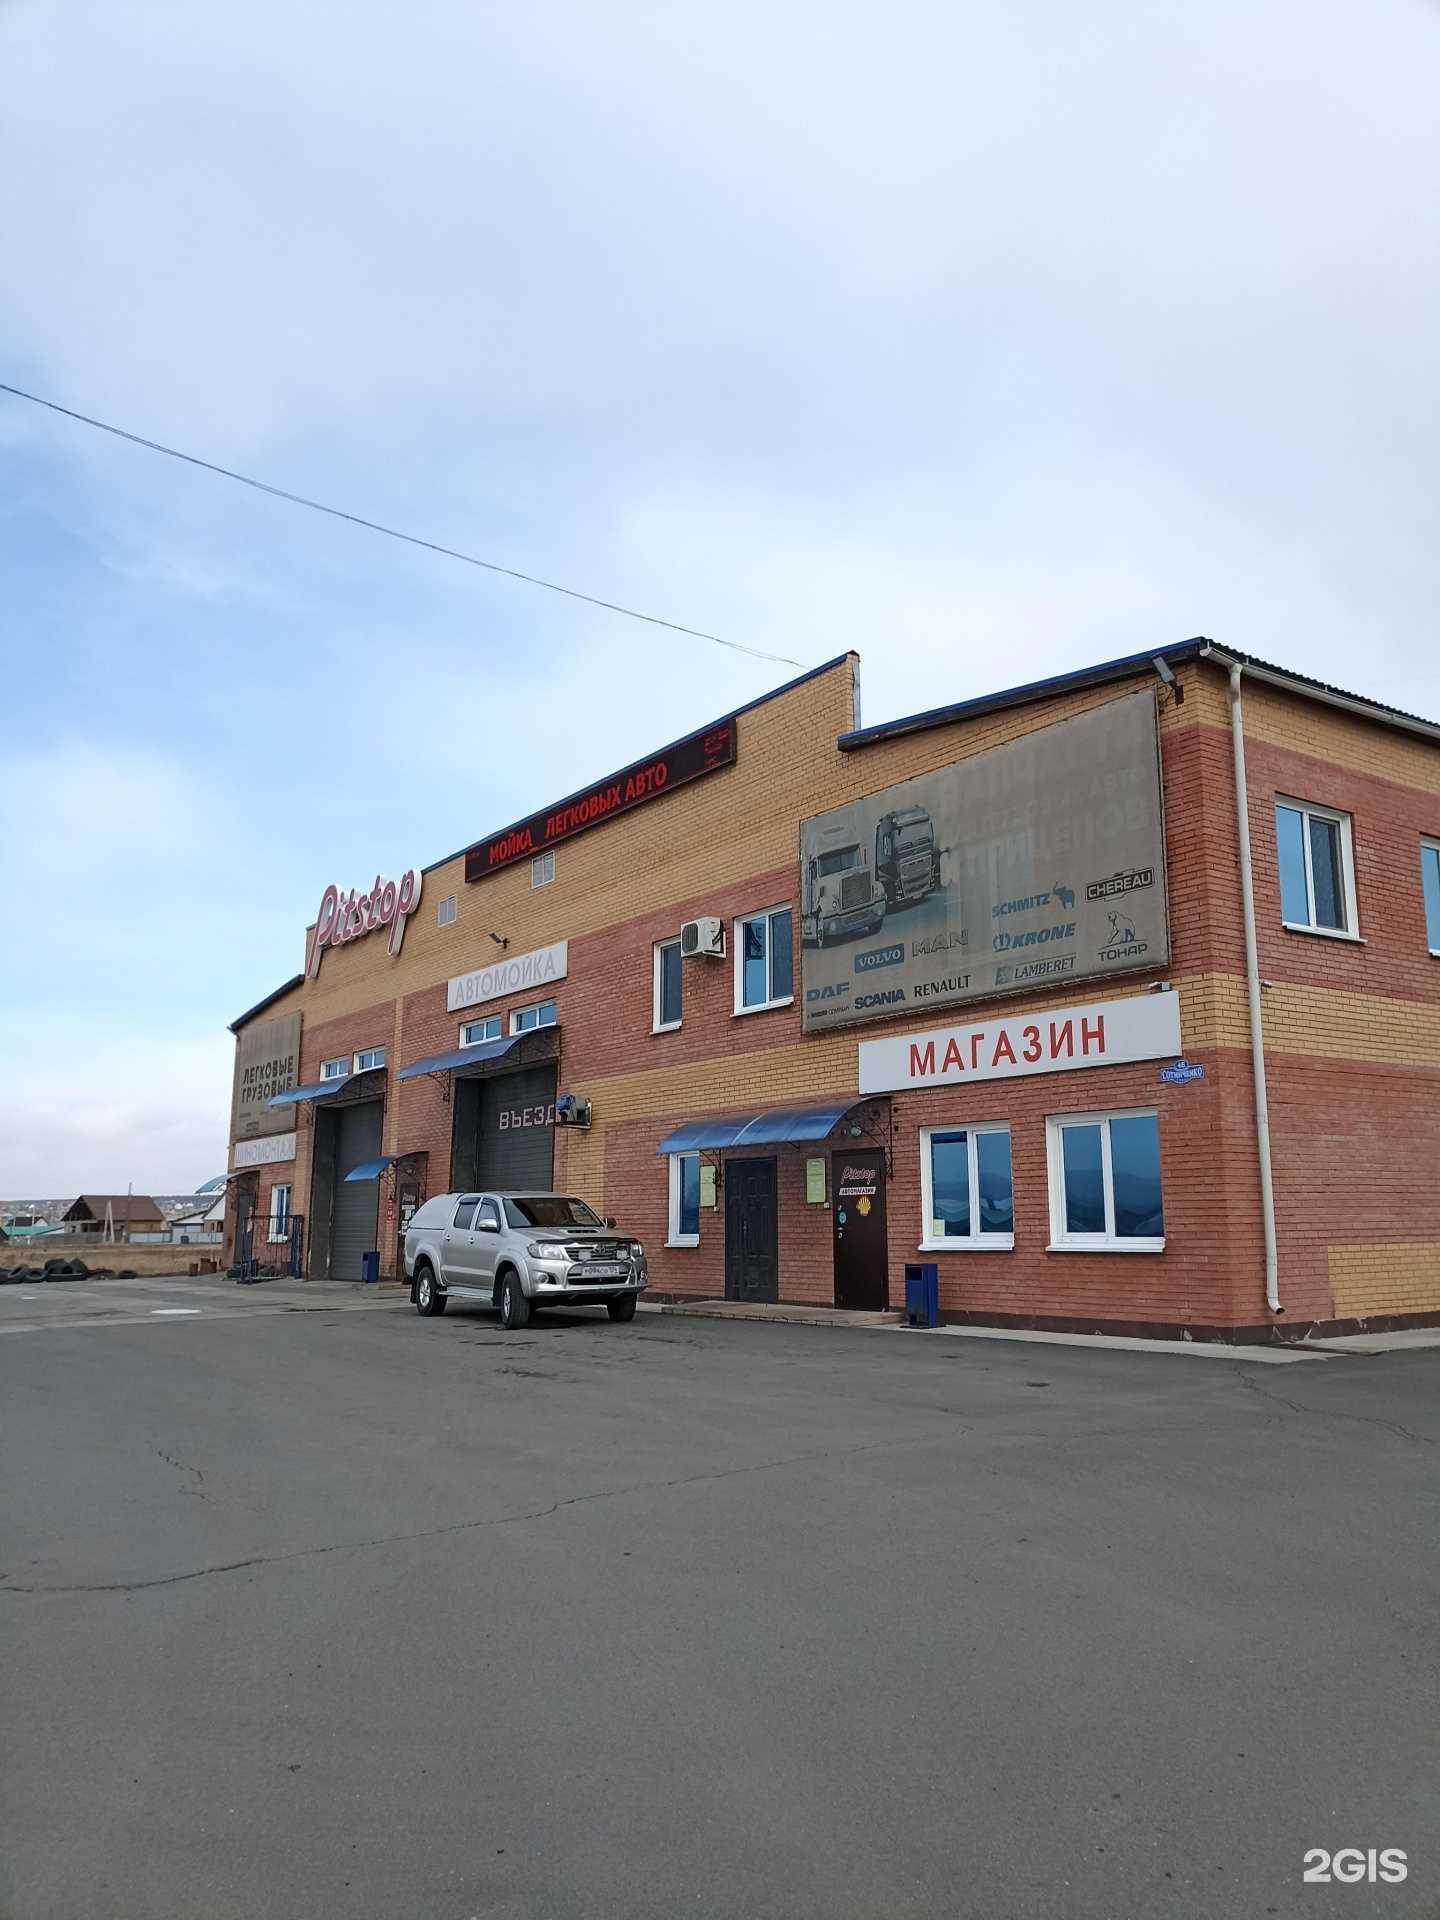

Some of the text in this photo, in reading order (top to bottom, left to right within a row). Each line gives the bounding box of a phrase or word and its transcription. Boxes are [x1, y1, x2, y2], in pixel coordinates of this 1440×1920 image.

[488, 761, 668, 865] МОЙКА ЛЕГКОВЫХ АВТО
[1088, 872, 1150, 898] CHEREAU
[992, 893, 1050, 918] SCHMITZ
[305, 869, 420, 978] Pitstop
[1012, 922, 1077, 949] KRONE
[912, 929, 969, 957] MAN
[858, 950, 901, 968] VOLVO
[1014, 956, 1077, 979] LAMBERET
[455, 951, 556, 1004] АВТОМОЙКА
[914, 975, 971, 998] RENAULT
[806, 981, 850, 1002] DAF
[854, 988, 906, 1010] SCANIA
[909, 1015, 1106, 1078] МАГАЗИН
[243, 1056, 294, 1085] ЛЕГКОВЫЕ
[241, 1076, 292, 1104] ГРУЗОВЫЕ
